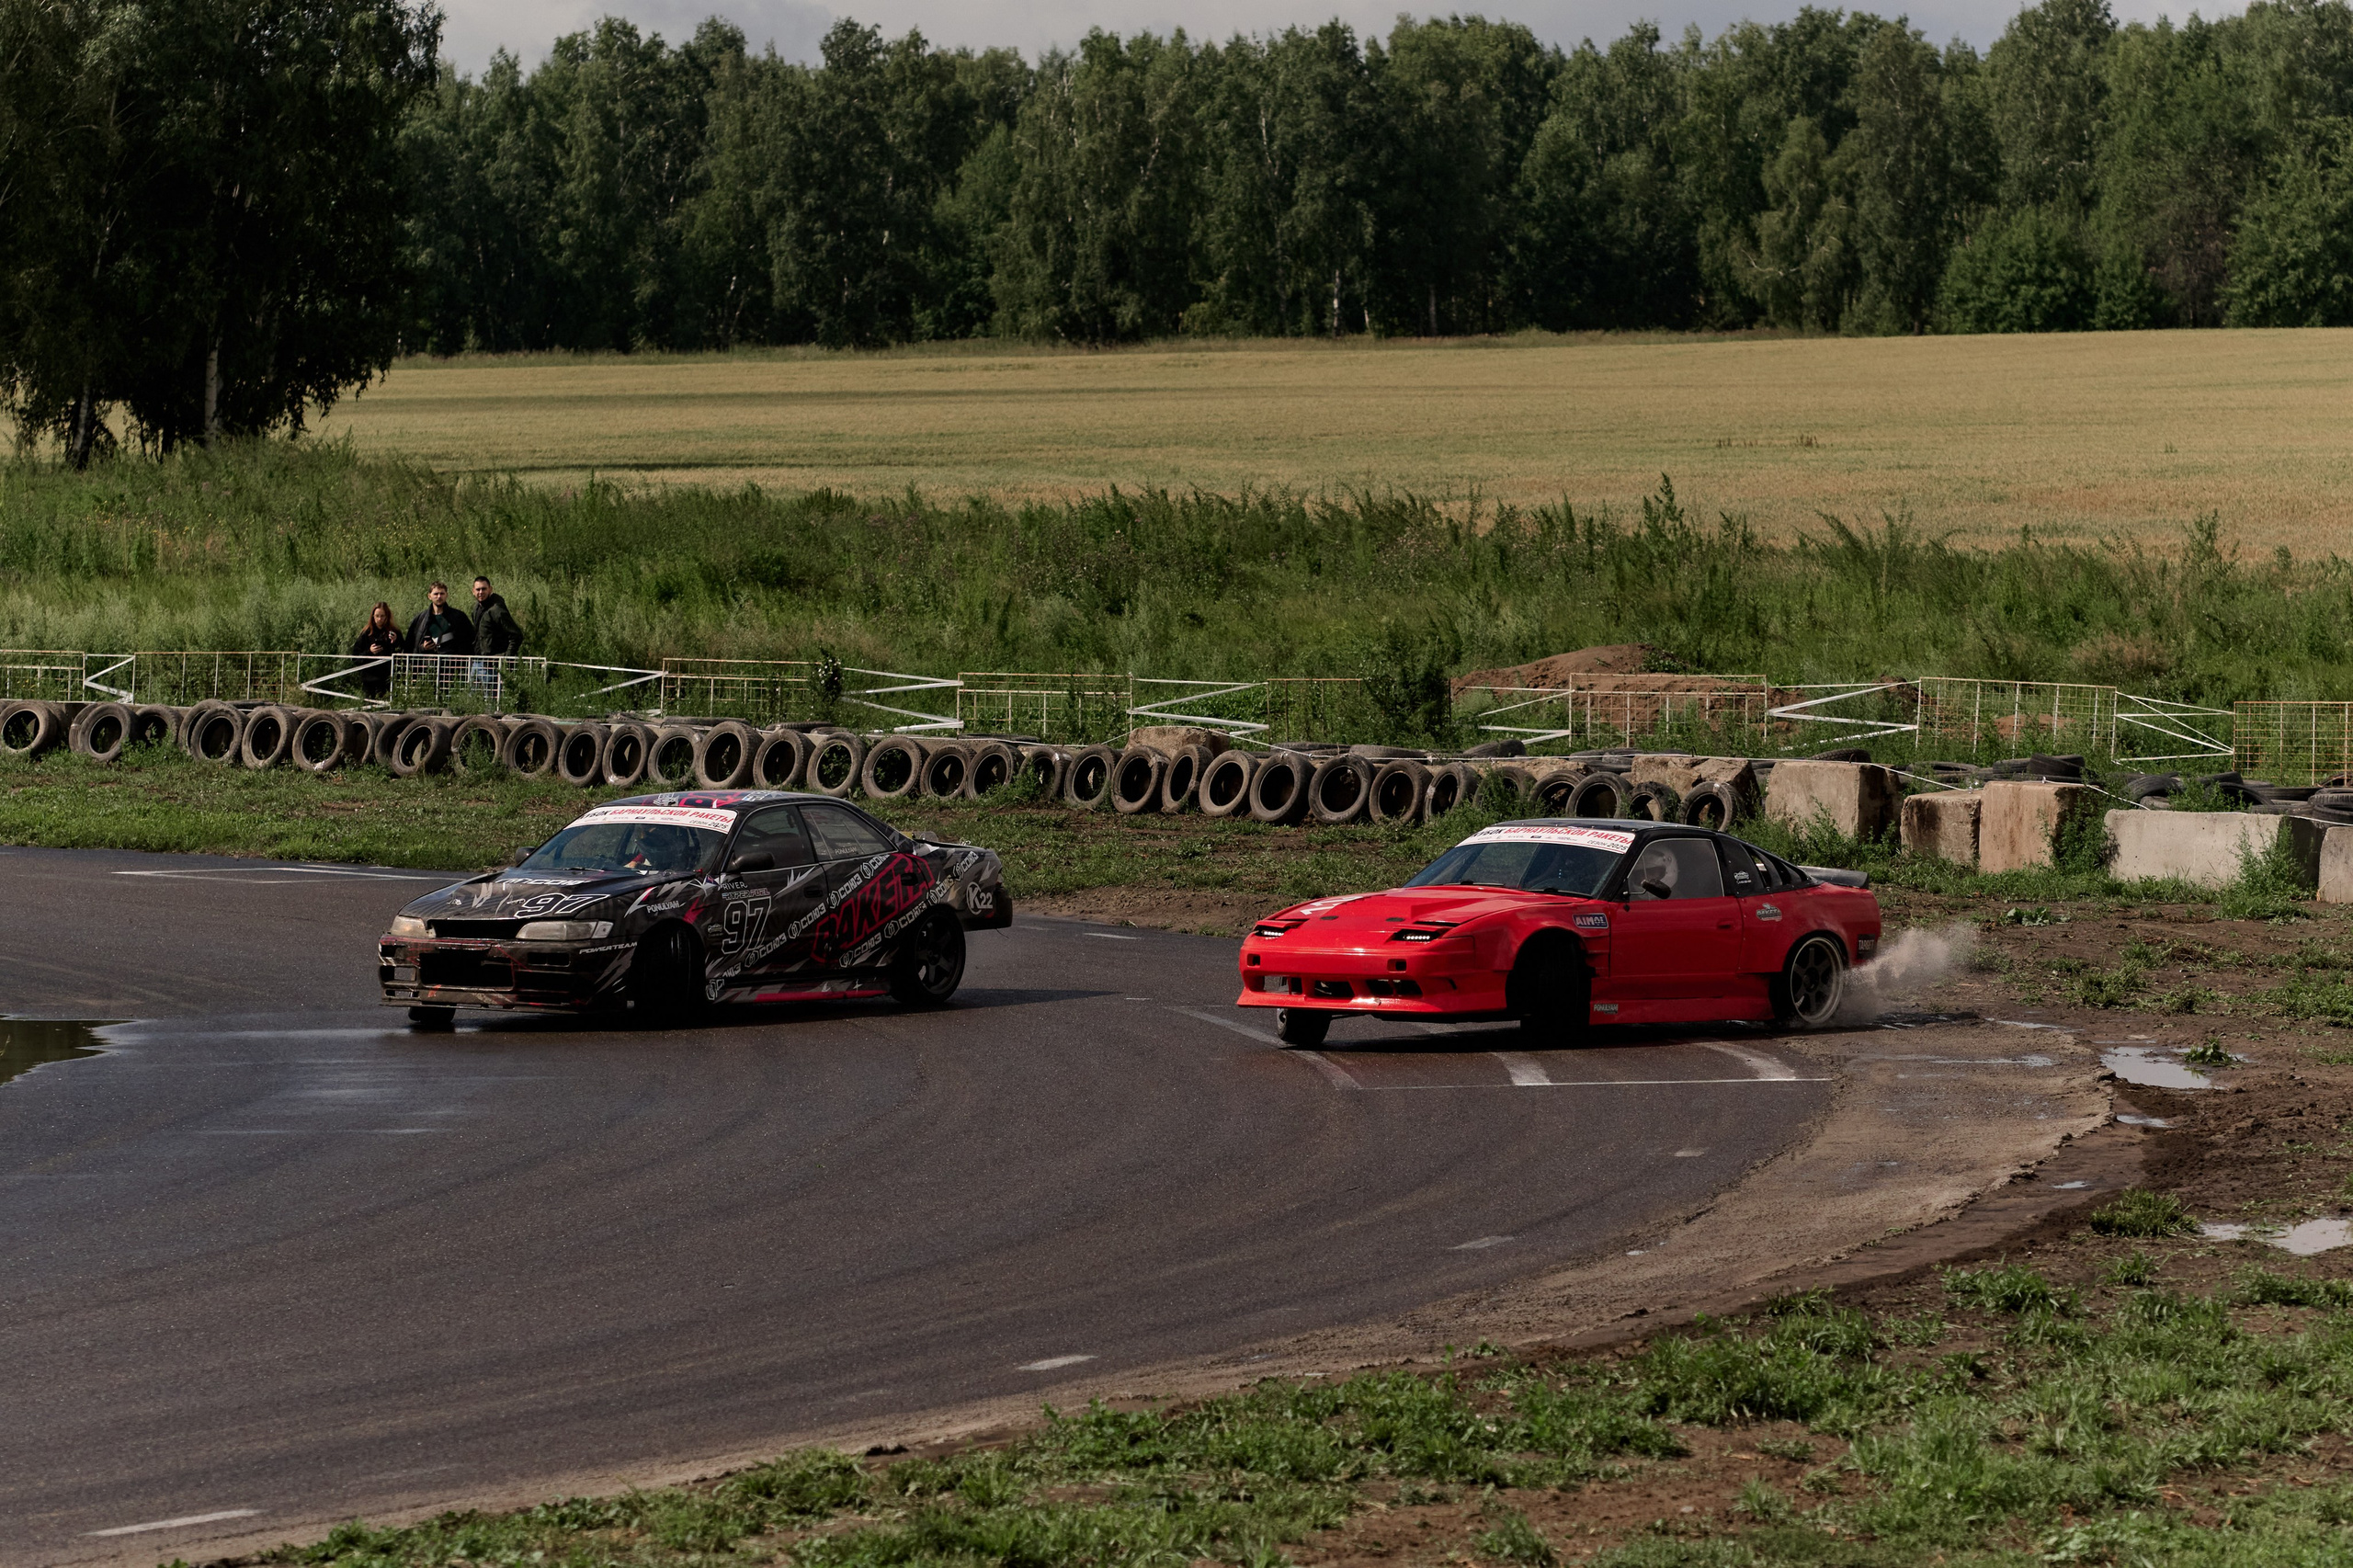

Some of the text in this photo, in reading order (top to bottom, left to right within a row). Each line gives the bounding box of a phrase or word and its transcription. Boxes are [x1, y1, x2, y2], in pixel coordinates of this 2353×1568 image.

[689, 812, 733, 823] РАКЕТЫ
[1504, 827, 1588, 836] БАРНАУЛЬСКОЙ
[1587, 832, 1633, 844] РАКЕТЫ
[722, 881, 748, 890] RIVER
[838, 873, 862, 899] СОЮЗ
[514, 892, 610, 919] 97
[801, 903, 826, 929] СОЮЗ
[722, 896, 771, 955] 97
[759, 932, 787, 958] СОЮЗ
[853, 932, 881, 958] СОЮЗ
